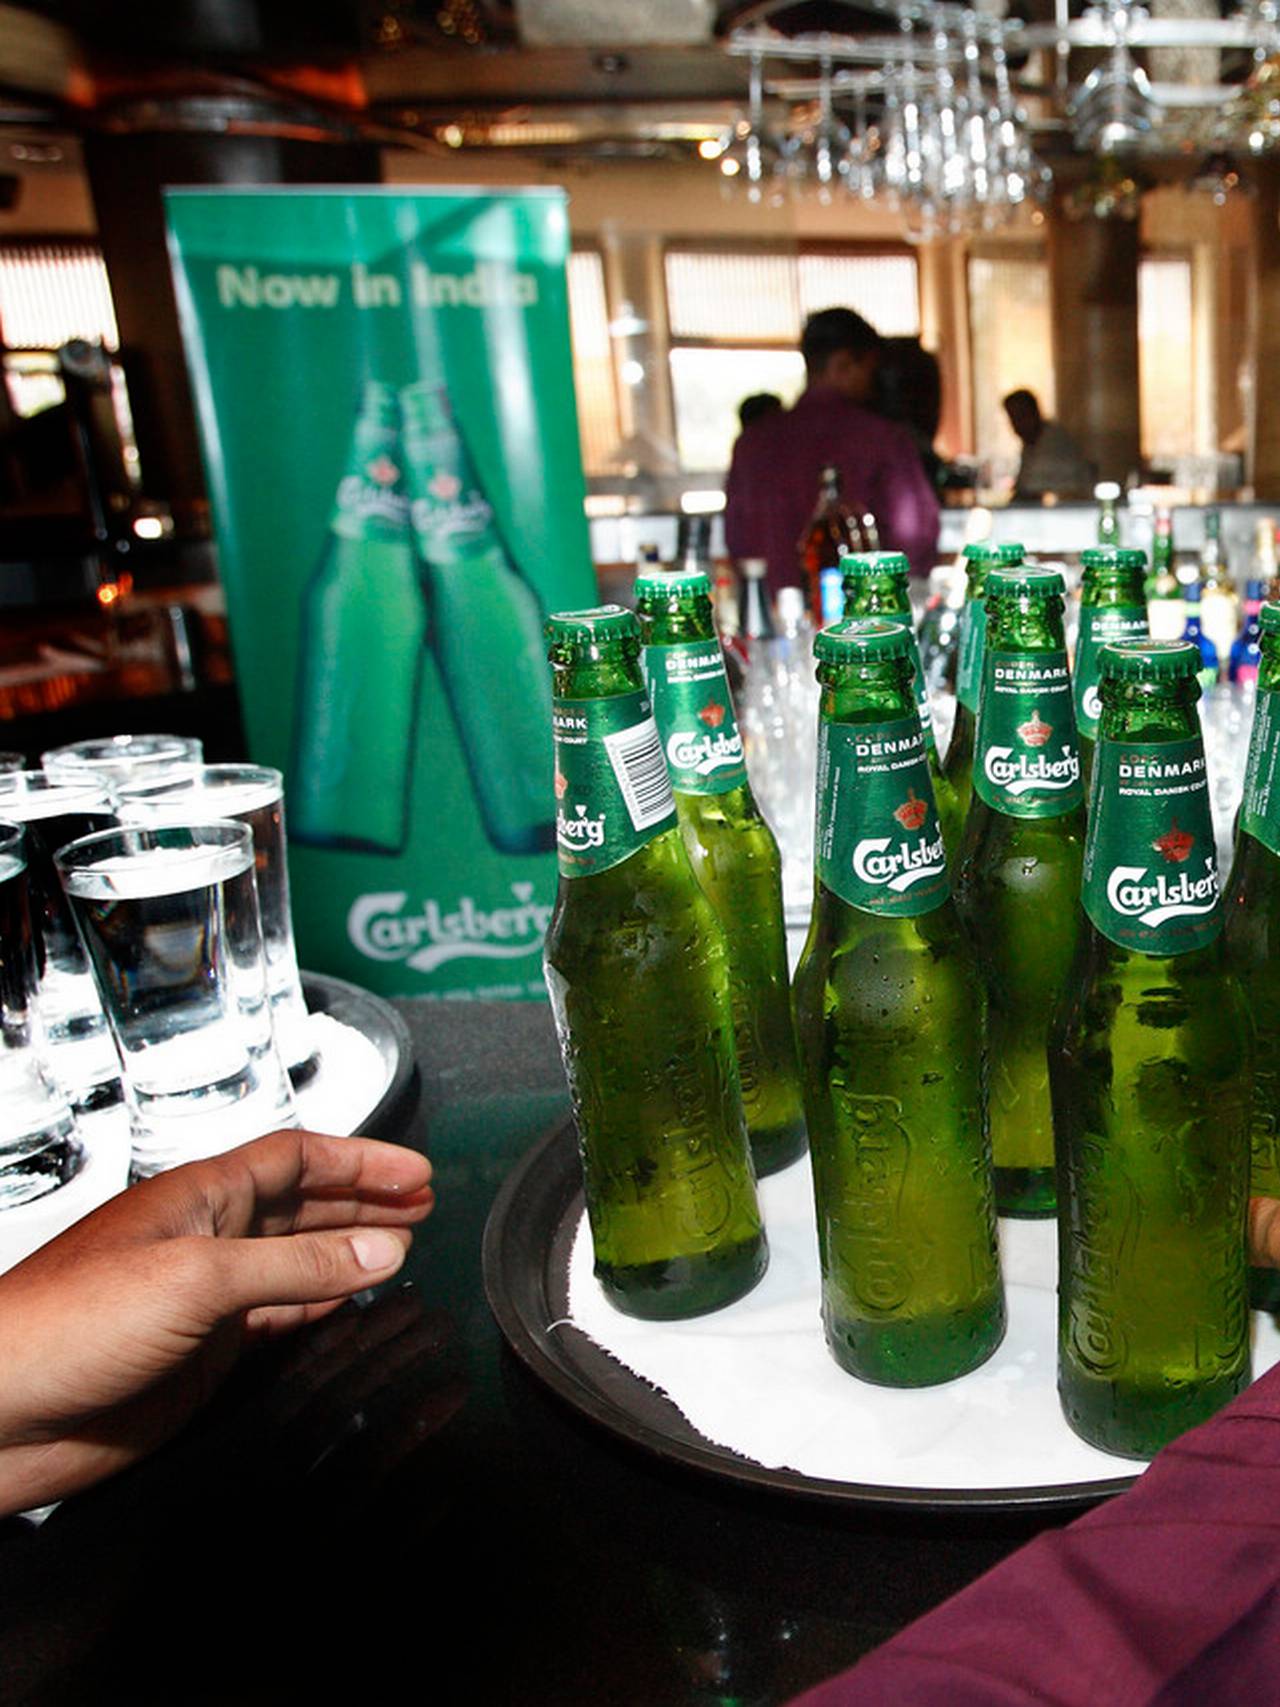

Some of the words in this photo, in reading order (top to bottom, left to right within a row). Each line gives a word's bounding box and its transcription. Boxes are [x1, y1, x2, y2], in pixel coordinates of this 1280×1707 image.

[216, 264, 340, 308] Now
[351, 262, 402, 309] in
[408, 261, 539, 308] Inda
[984, 744, 1080, 796] Carlsberg
